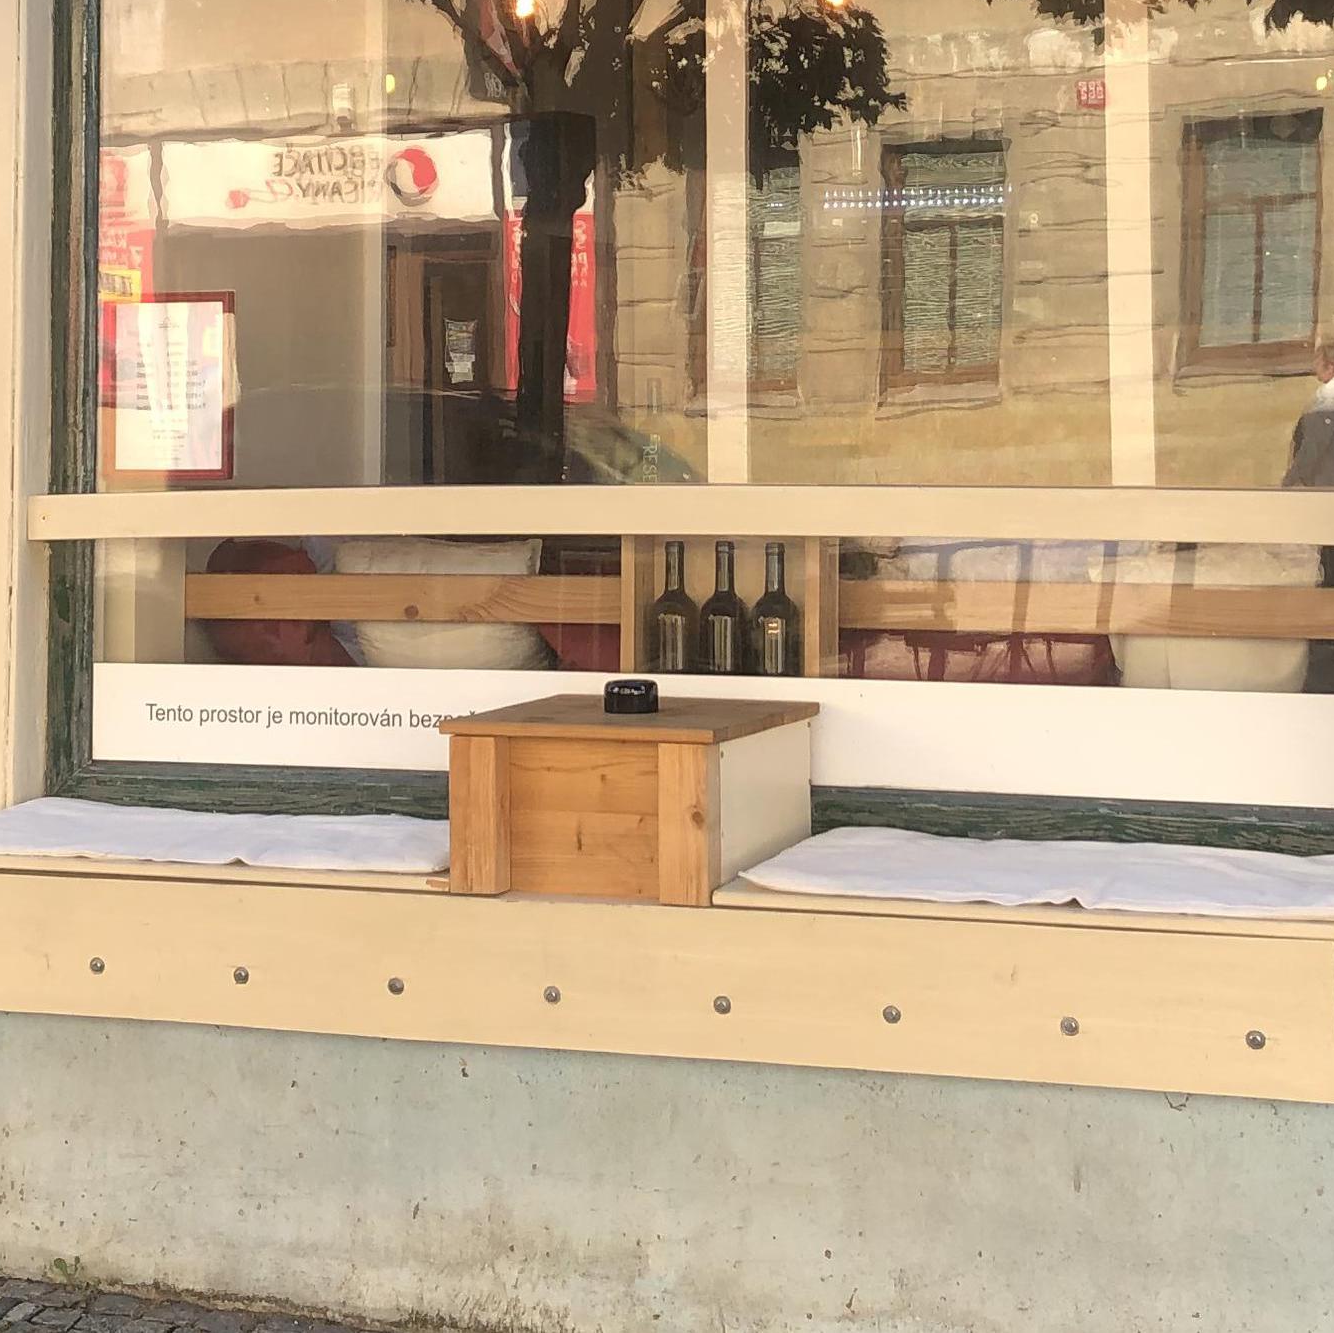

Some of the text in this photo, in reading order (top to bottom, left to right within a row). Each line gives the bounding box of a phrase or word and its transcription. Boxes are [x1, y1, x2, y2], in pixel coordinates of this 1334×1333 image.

[145, 703, 194, 723] Tento
[198, 706, 263, 727] prostor
[265, 706, 284, 729] je
[289, 707, 403, 728] monitorován
